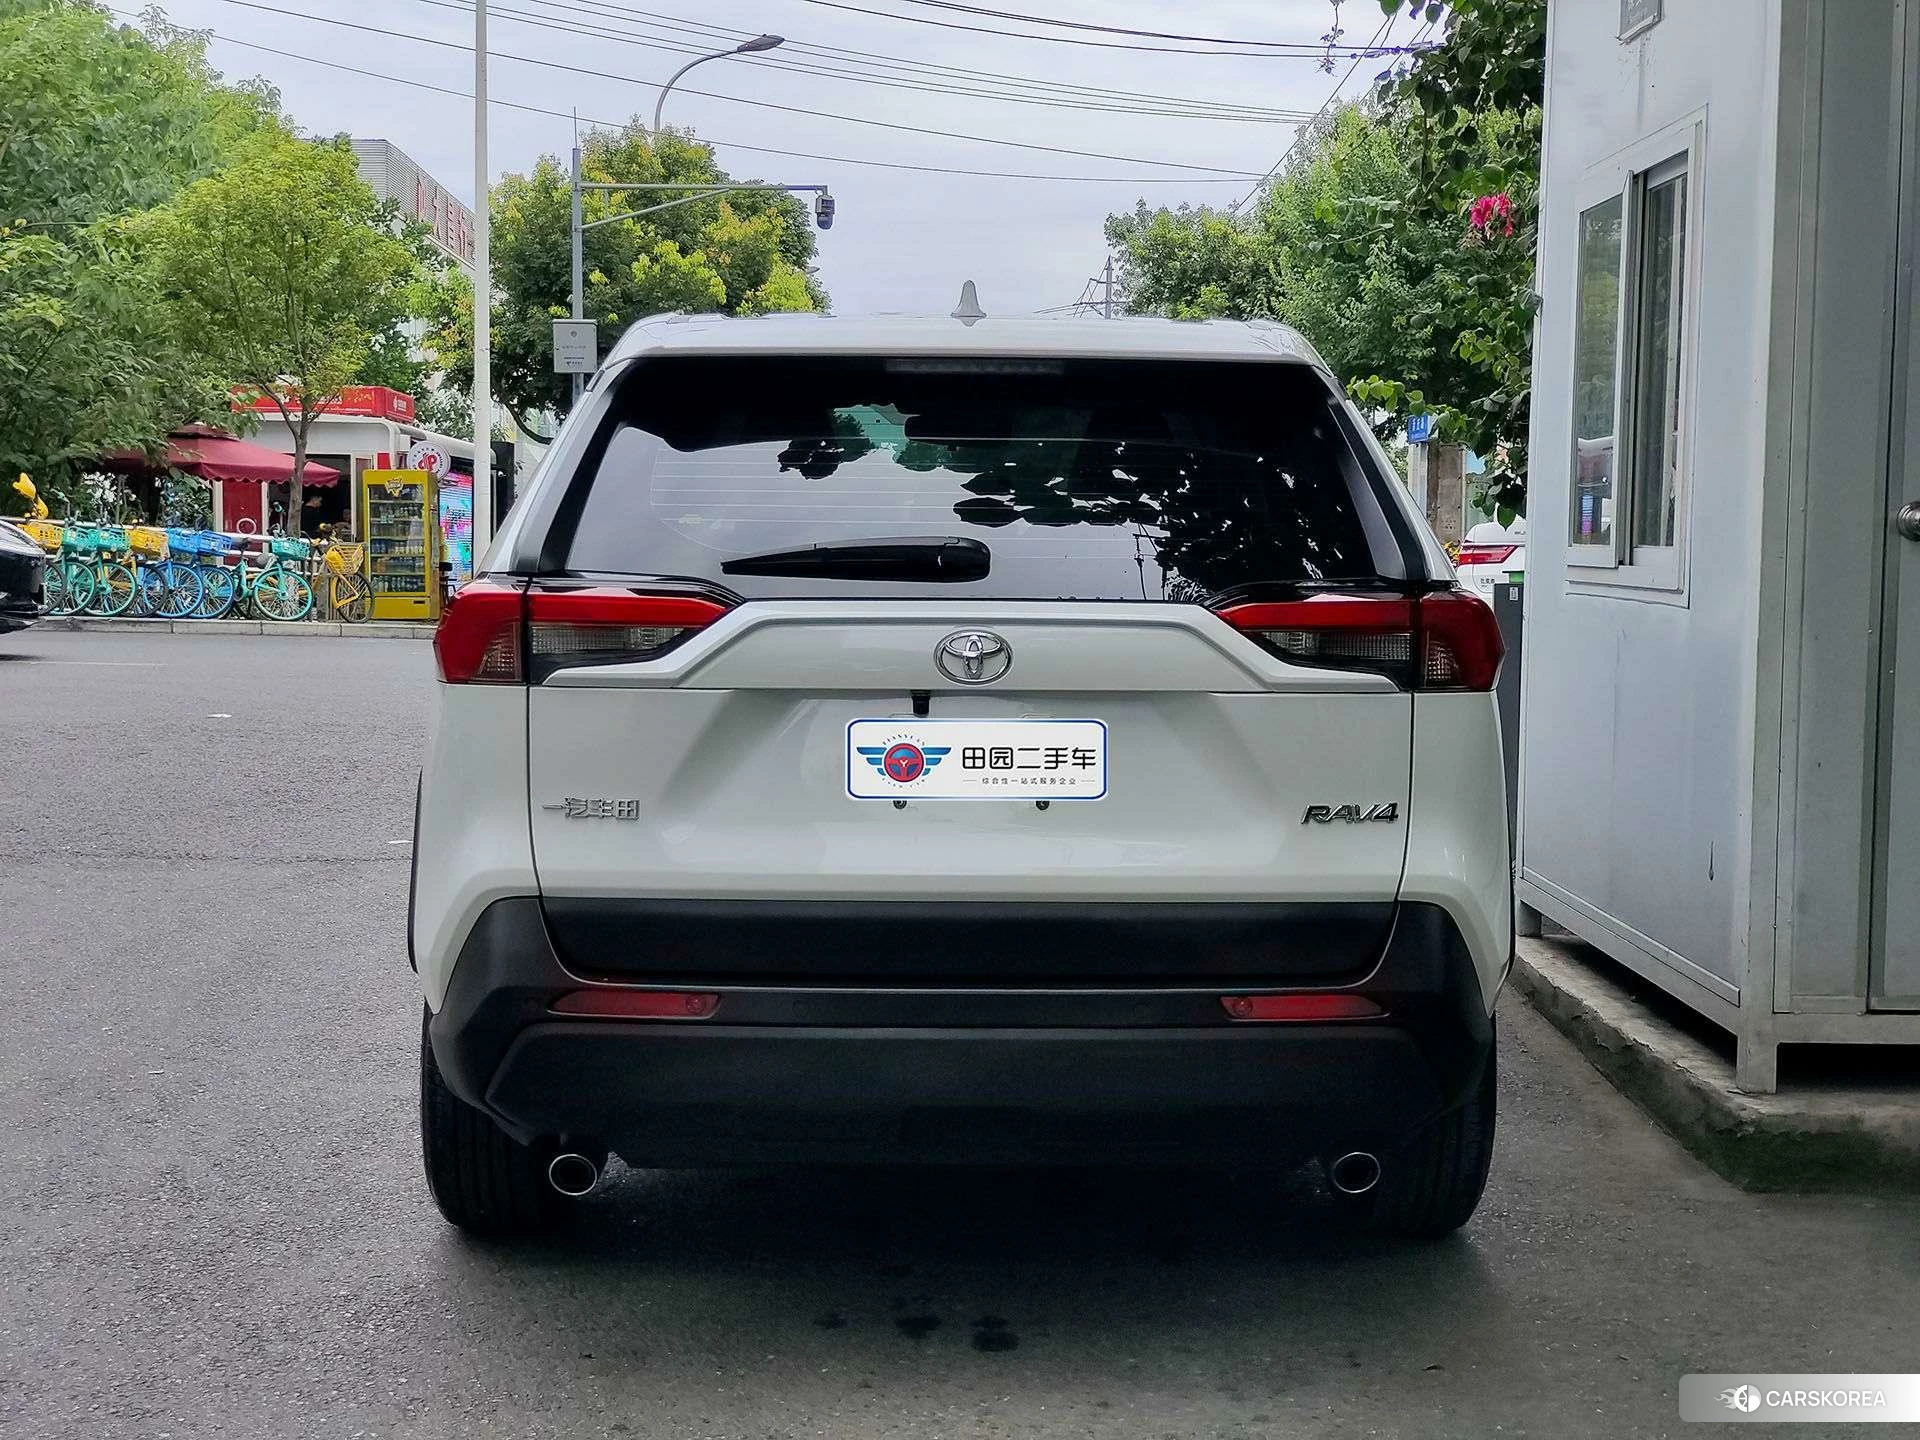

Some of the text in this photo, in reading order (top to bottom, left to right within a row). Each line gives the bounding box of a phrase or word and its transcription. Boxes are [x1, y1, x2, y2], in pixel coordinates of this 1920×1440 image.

[962, 746, 1097, 770] 田园二手车
[1301, 802, 1399, 824] RAV4
